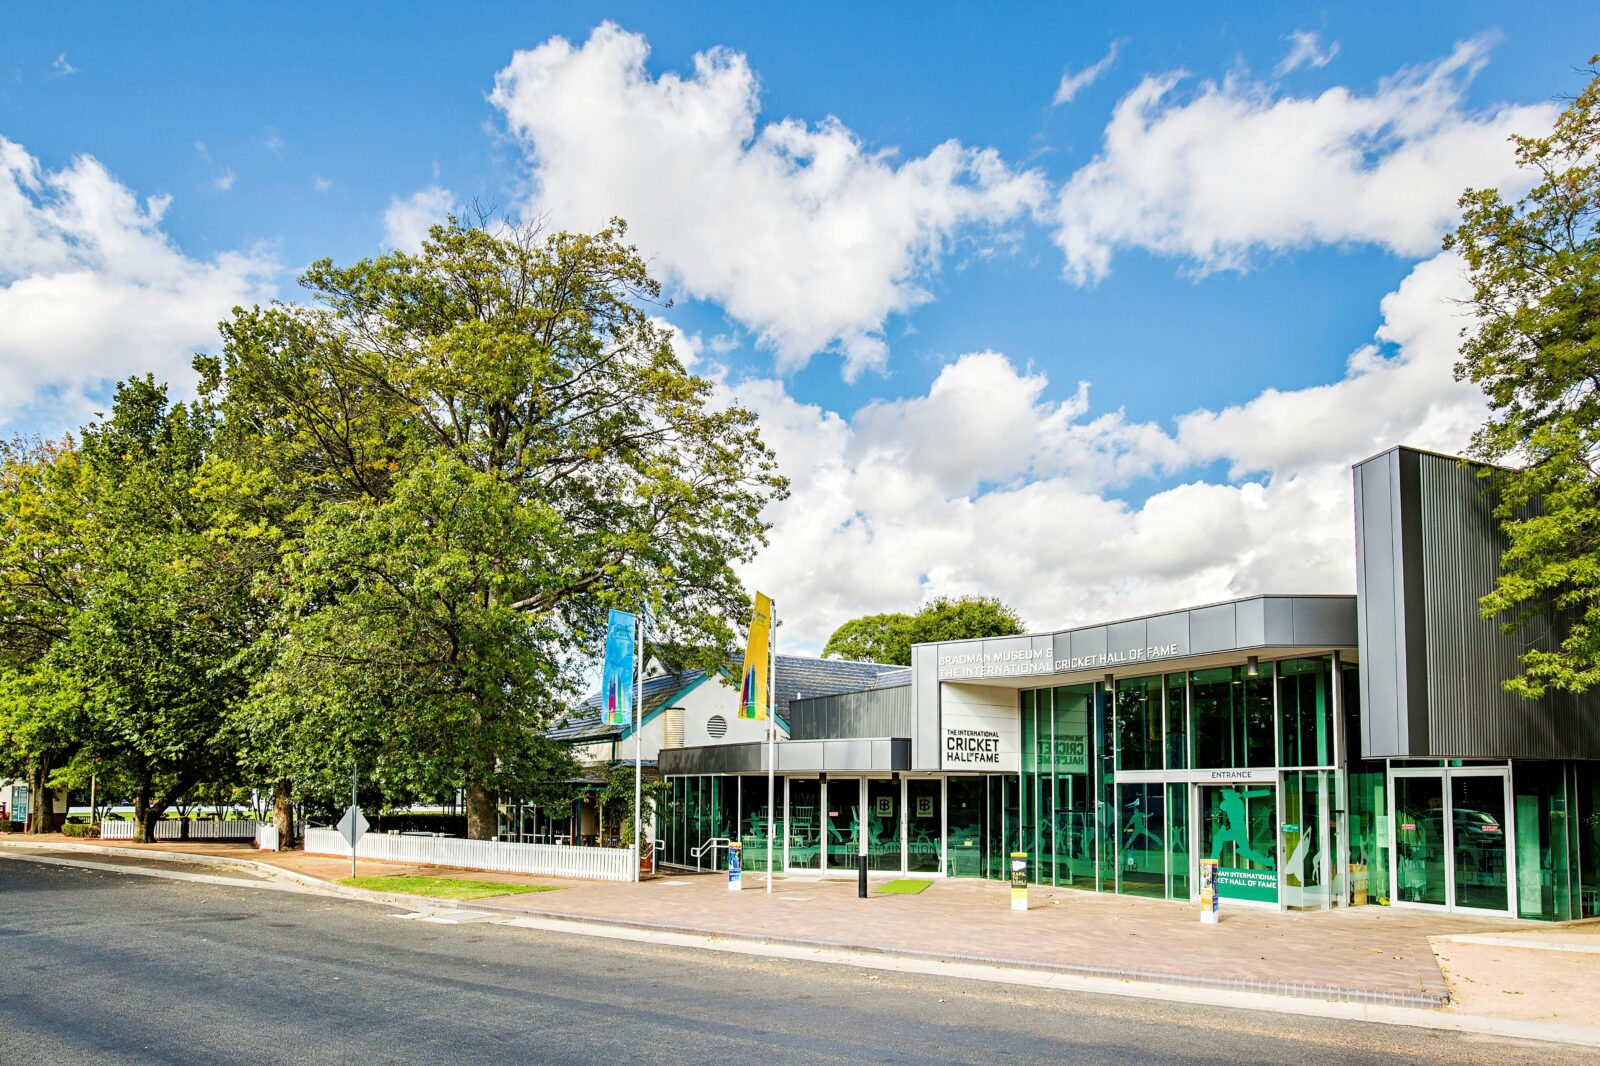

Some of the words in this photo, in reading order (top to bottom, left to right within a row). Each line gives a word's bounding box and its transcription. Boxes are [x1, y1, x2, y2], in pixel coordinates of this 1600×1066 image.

[938, 652, 991, 666] BRADMAN
[994, 648, 1043, 662] MUSEUM
[1045, 647, 1054, 658] &
[939, 667, 960, 678] THE
[962, 661, 1053, 677] INTERNATIONAL
[1054, 654, 1098, 671] CRICKET
[1099, 651, 1127, 665] HALL
[1129, 648, 1145, 660] OF
[1146, 643, 1179, 658] FAME
[957, 729, 999, 738] INTERNATIONAL
[947, 736, 1000, 752] CRICKET
[946, 751, 972, 762] HALL
[974, 752, 1000, 763] FAME
[1211, 771, 1253, 779] ENTRANCE
[846, 843, 938, 854] DEERMINTION
[1229, 871, 1277, 881] INTERNATIONAL
[1229, 878, 1247, 886] HALL
[1247, 879, 1258, 887] OF
[1257, 880, 1277, 889] FAME
